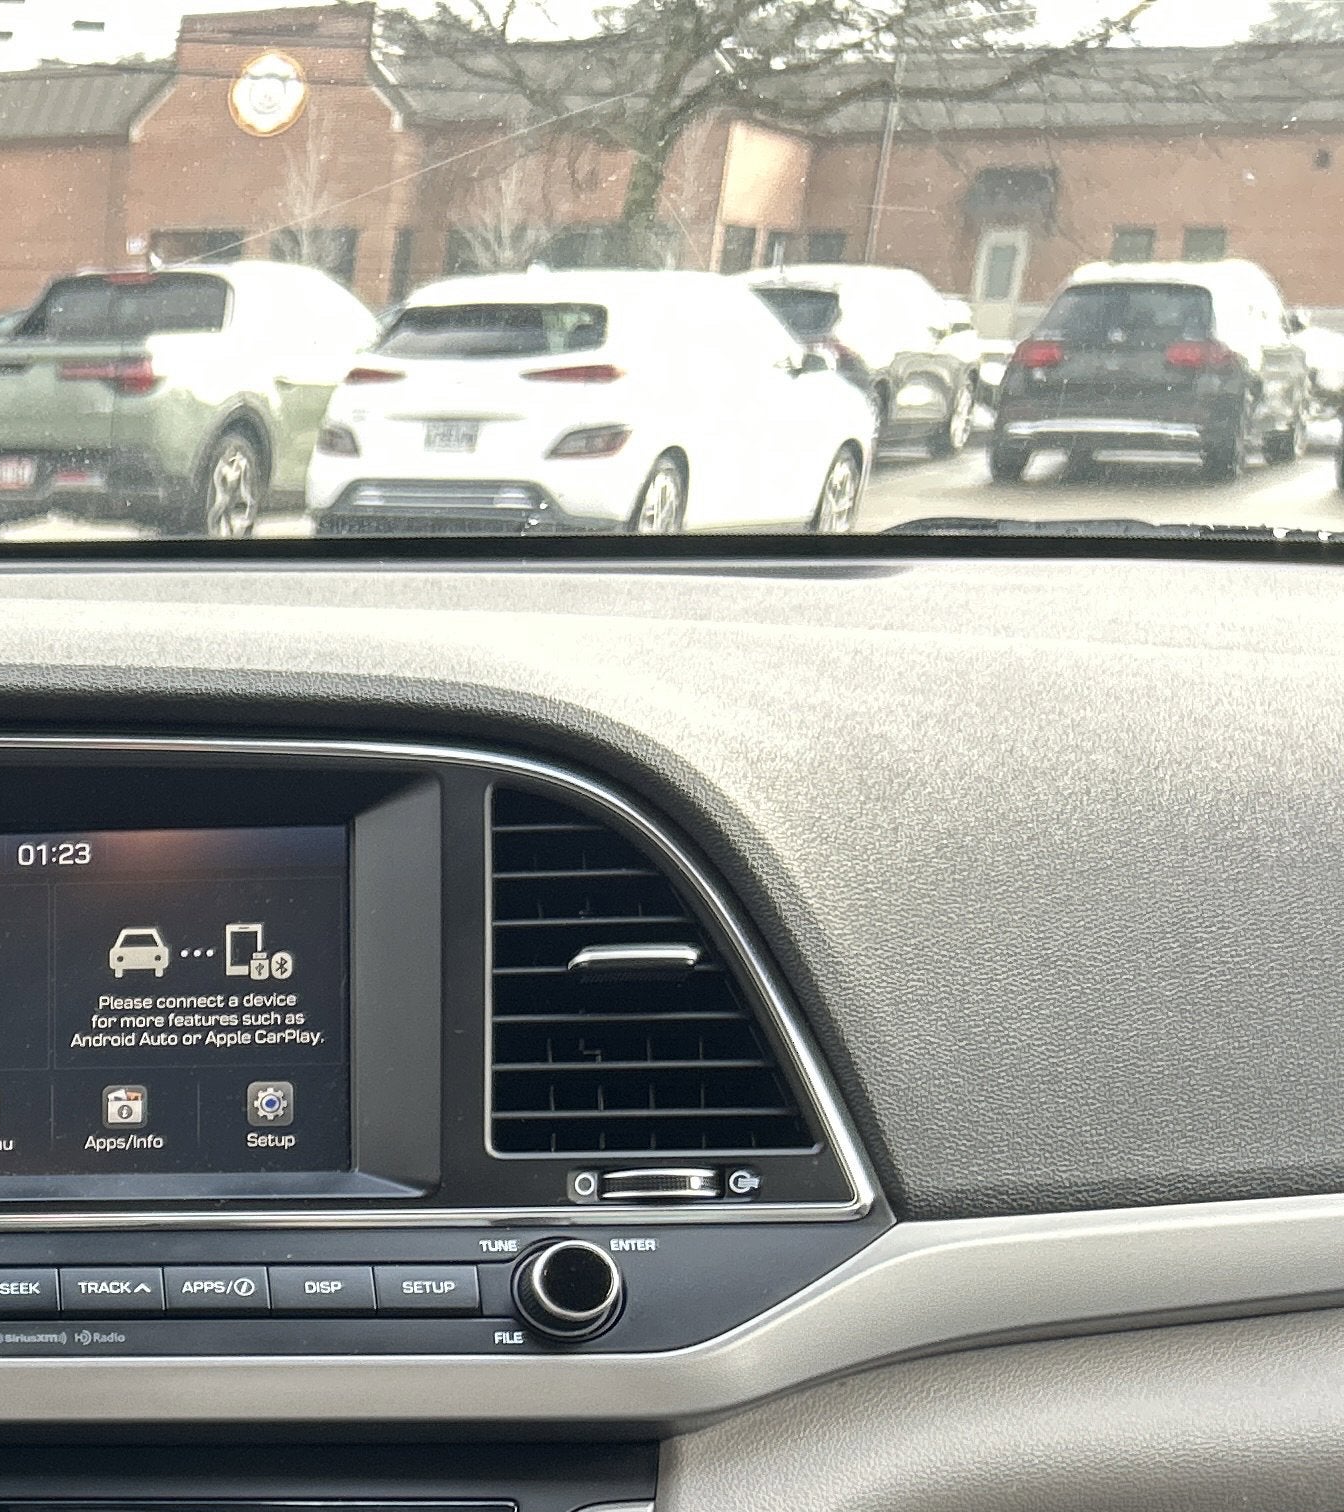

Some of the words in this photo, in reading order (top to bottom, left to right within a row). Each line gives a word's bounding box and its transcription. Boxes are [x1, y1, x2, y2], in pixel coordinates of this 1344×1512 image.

[18, 842, 92, 866] 01:23
[98, 995, 153, 1010] Please
[156, 994, 225, 1009] connect
[228, 995, 239, 1008] a
[242, 992, 297, 1008] device
[91, 1014, 118, 1029] for
[120, 1015, 165, 1028] more
[167, 1012, 239, 1027] features
[242, 1010, 282, 1026] such
[284, 1012, 306, 1025] as
[70, 1032, 136, 1048] Android
[138, 1031, 178, 1047] Auto
[182, 1033, 203, 1046] or
[204, 1030, 252, 1048] Apple
[254, 1028, 325, 1047] CarPlay.
[84, 1133, 164, 1152] Apps/Info
[246, 1132, 296, 1150] Setup
[478, 1239, 518, 1252] TUNE
[609, 1238, 656, 1252] ENTER
[0, 1281, 41, 1295] SEEK
[77, 1280, 132, 1294] TRACK
[304, 1280, 343, 1294] DISP
[402, 1280, 456, 1294] SETUP
[92, 1332, 126, 1344] Radio
[494, 1331, 524, 1345] FILE
